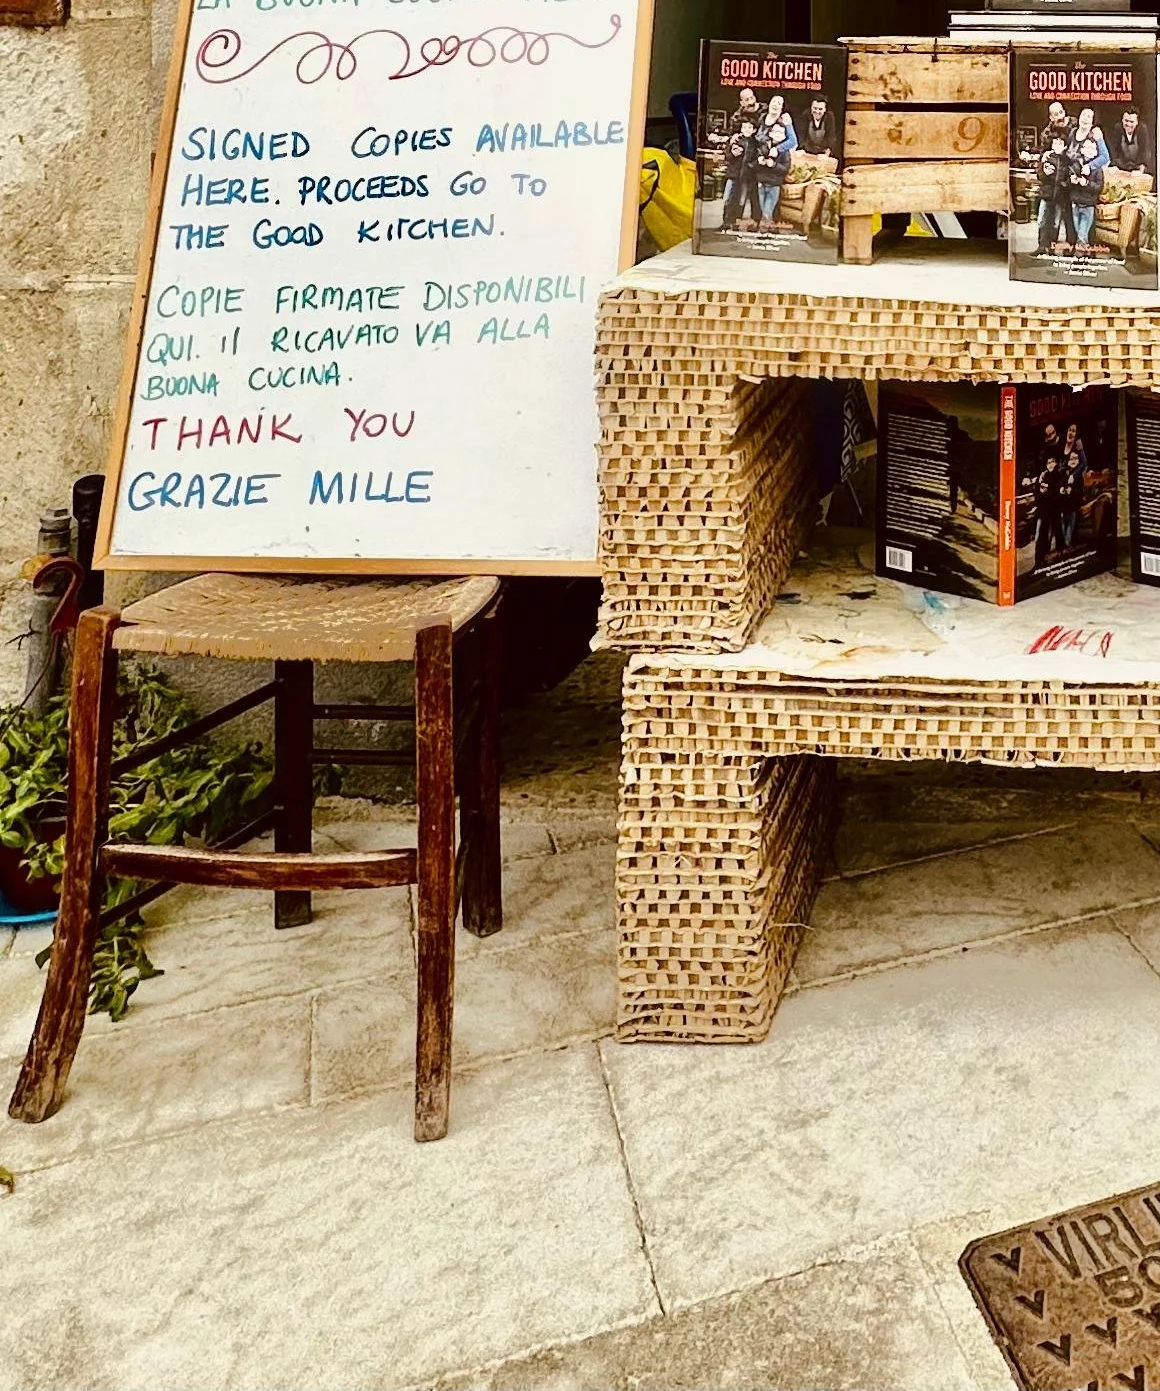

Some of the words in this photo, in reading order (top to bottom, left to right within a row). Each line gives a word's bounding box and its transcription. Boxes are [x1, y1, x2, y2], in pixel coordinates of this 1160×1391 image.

[721, 58, 759, 78] GOOD
[762, 60, 823, 81] KITCHEN
[1029, 71, 1067, 91] GOOD
[1071, 71, 1132, 91] KITCHEN
[181, 127, 311, 161] SIGNED
[350, 126, 454, 159] COPIES
[476, 120, 624, 148] AVAILABLE
[180, 173, 281, 207] HERE.
[298, 173, 430, 206] PROCEEDS
[449, 171, 487, 196] GO
[512, 173, 547, 197] TO
[169, 223, 229, 251] THE
[252, 218, 324, 249] GOOD
[357, 214, 506, 243] KITCHEN.
[156, 284, 246, 319] COPIE
[274, 285, 406, 316] FIRMATE
[422, 275, 586, 312] DISPONIBILI
[146, 332, 200, 366] QUI.
[271, 324, 400, 354] RICAVATO
[415, 321, 452, 347] VA
[476, 312, 551, 345] ALLA
[141, 372, 221, 402] BUONA
[248, 362, 354, 393] CUCINA.
[142, 413, 303, 451] THANK
[343, 408, 417, 443] YOU
[127, 471, 282, 511] GRAZIE
[308, 470, 434, 506] MILLE
